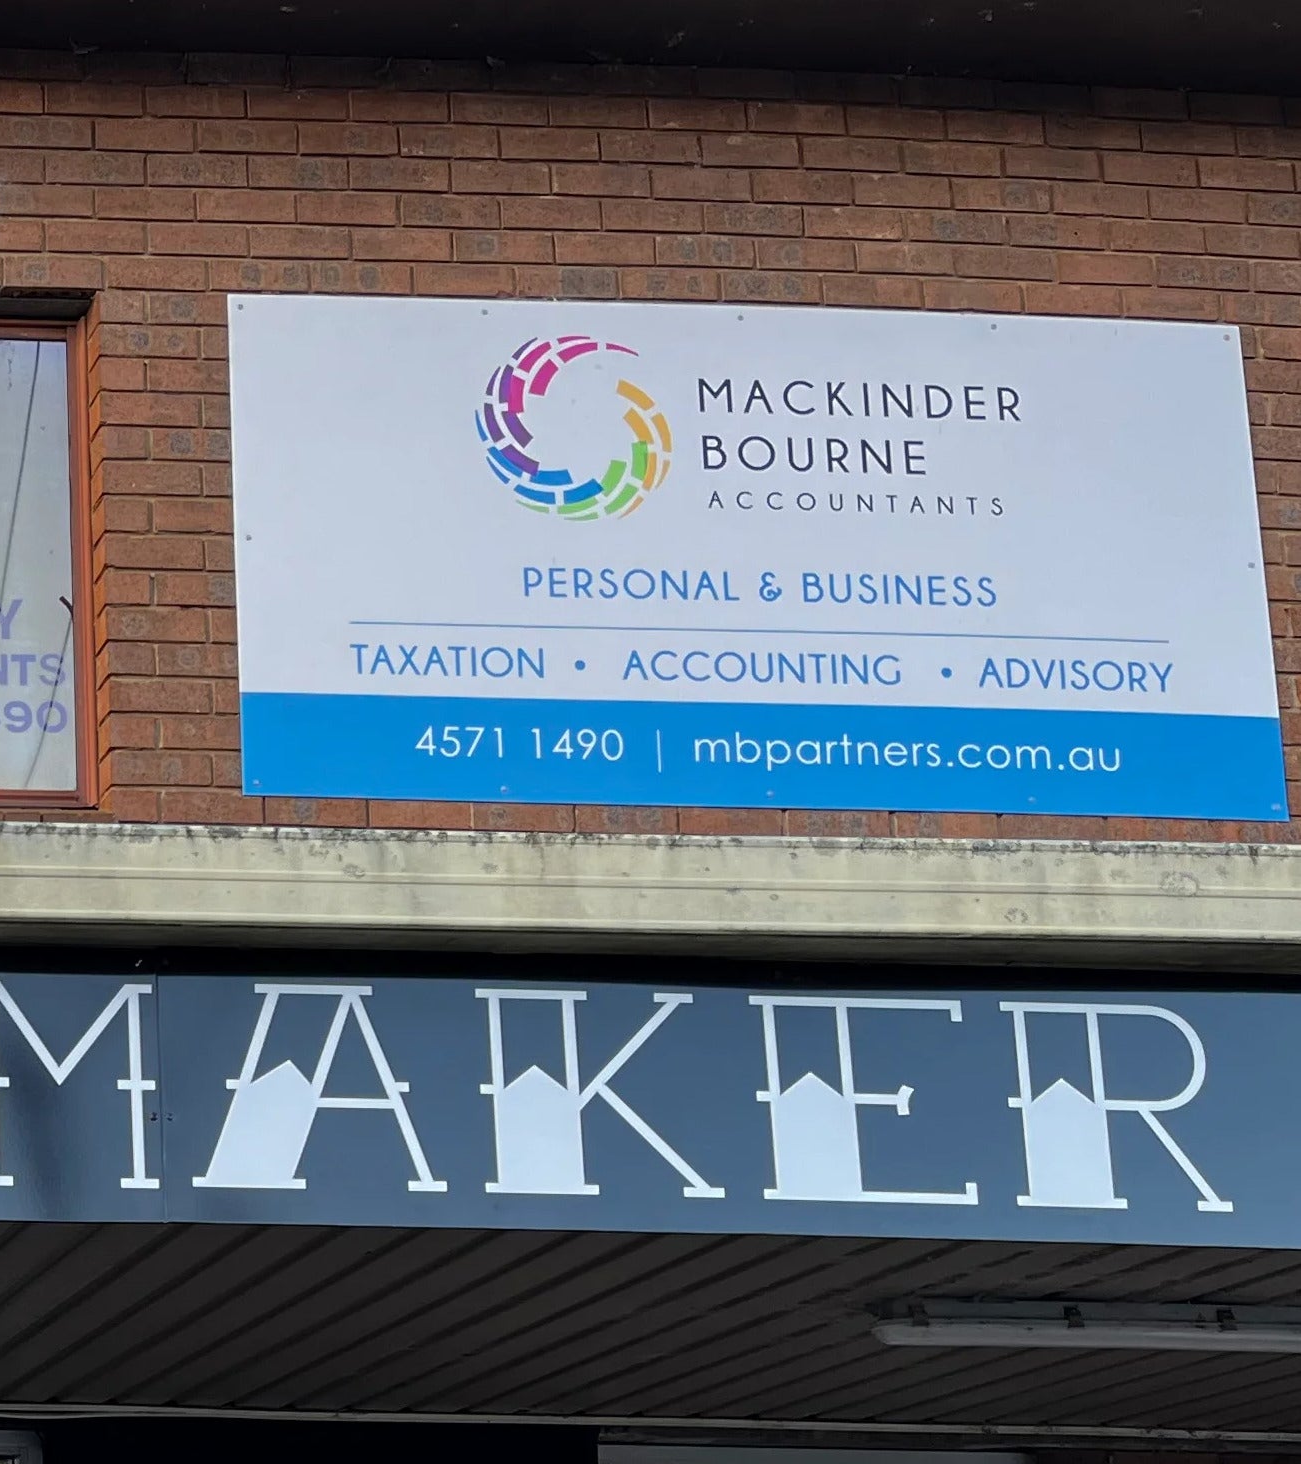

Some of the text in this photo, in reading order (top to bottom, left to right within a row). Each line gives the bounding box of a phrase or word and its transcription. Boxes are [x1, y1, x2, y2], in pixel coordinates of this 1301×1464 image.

[698, 377, 1023, 424] MACKINDER
[700, 434, 929, 476] BOURNE
[707, 490, 1006, 517] ACCOUNTANTS
[522, 566, 999, 608] PERSONAL & BUSINESS
[349, 642, 1174, 693] TAXATION ACCOUNTING ADVISORY
[414, 726, 1122, 774] 4571 1490 mbpartners.com.au
